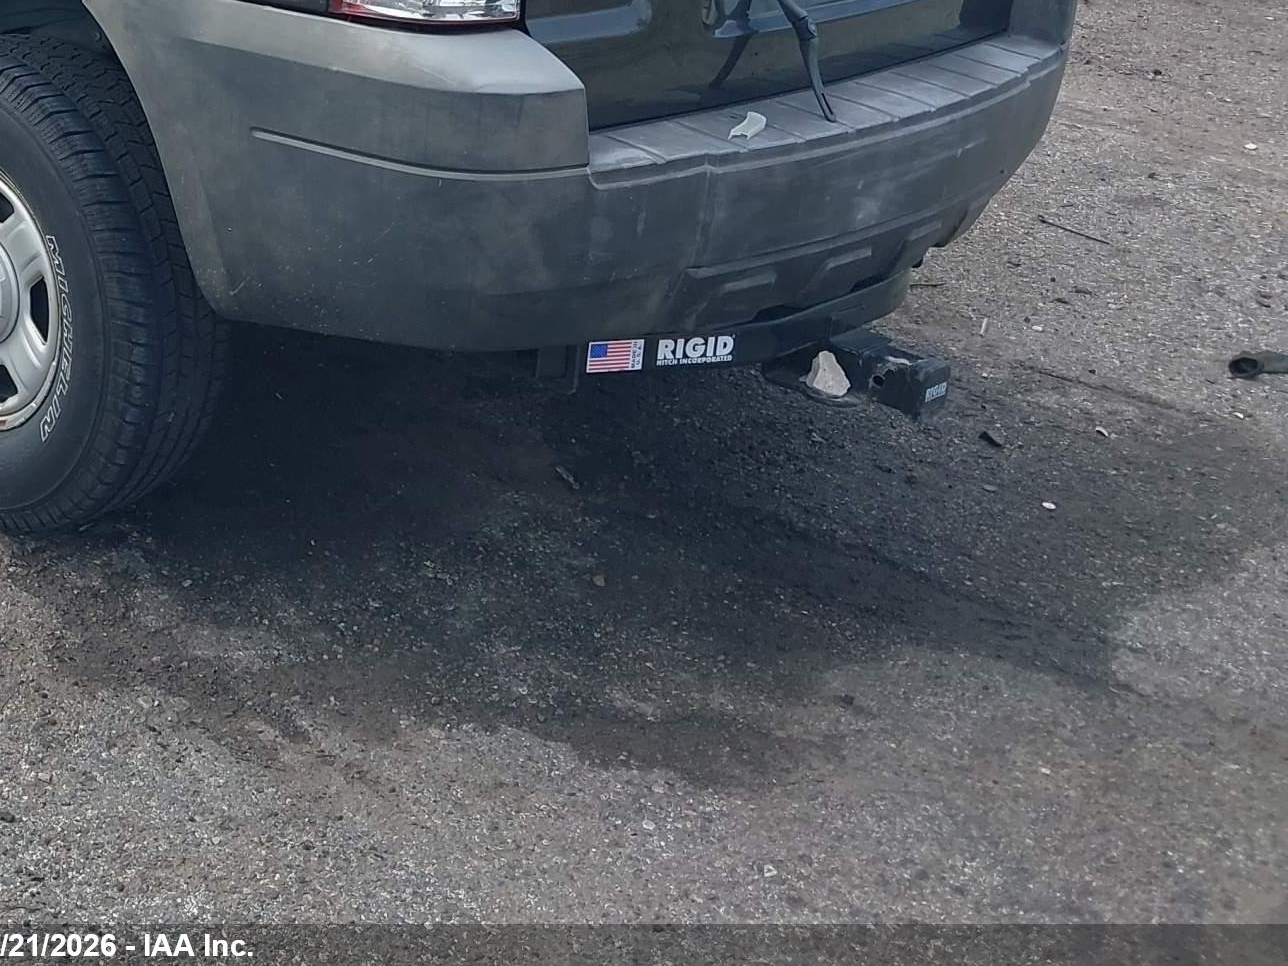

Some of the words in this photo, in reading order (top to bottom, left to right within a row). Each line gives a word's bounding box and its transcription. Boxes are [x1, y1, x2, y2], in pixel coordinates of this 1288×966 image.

[40, 235, 73, 442] MICHELIN
[657, 335, 734, 359] RIGID
[656, 358, 678, 367] HITCH
[679, 354, 733, 365] INCORPORATED
